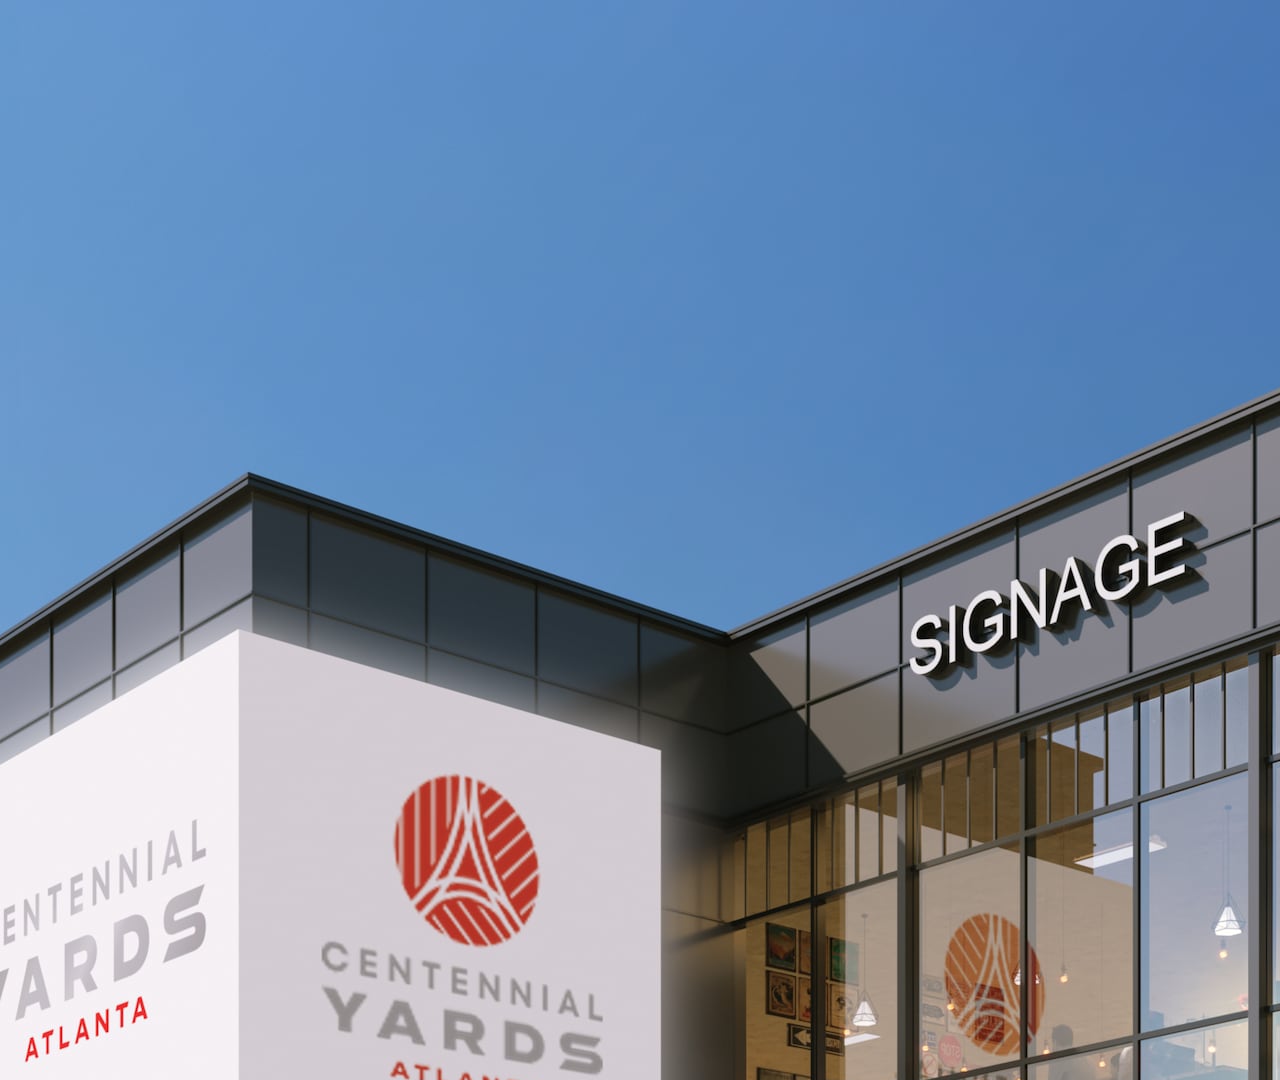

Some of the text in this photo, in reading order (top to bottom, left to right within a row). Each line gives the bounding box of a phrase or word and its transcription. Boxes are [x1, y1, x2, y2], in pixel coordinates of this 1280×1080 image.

[909, 510, 1186, 676] SIGNAGE
[321, 941, 604, 1023] CENTENNIAL
[24, 995, 149, 1063] ATLANTA
[322, 986, 604, 1076] YARDS
